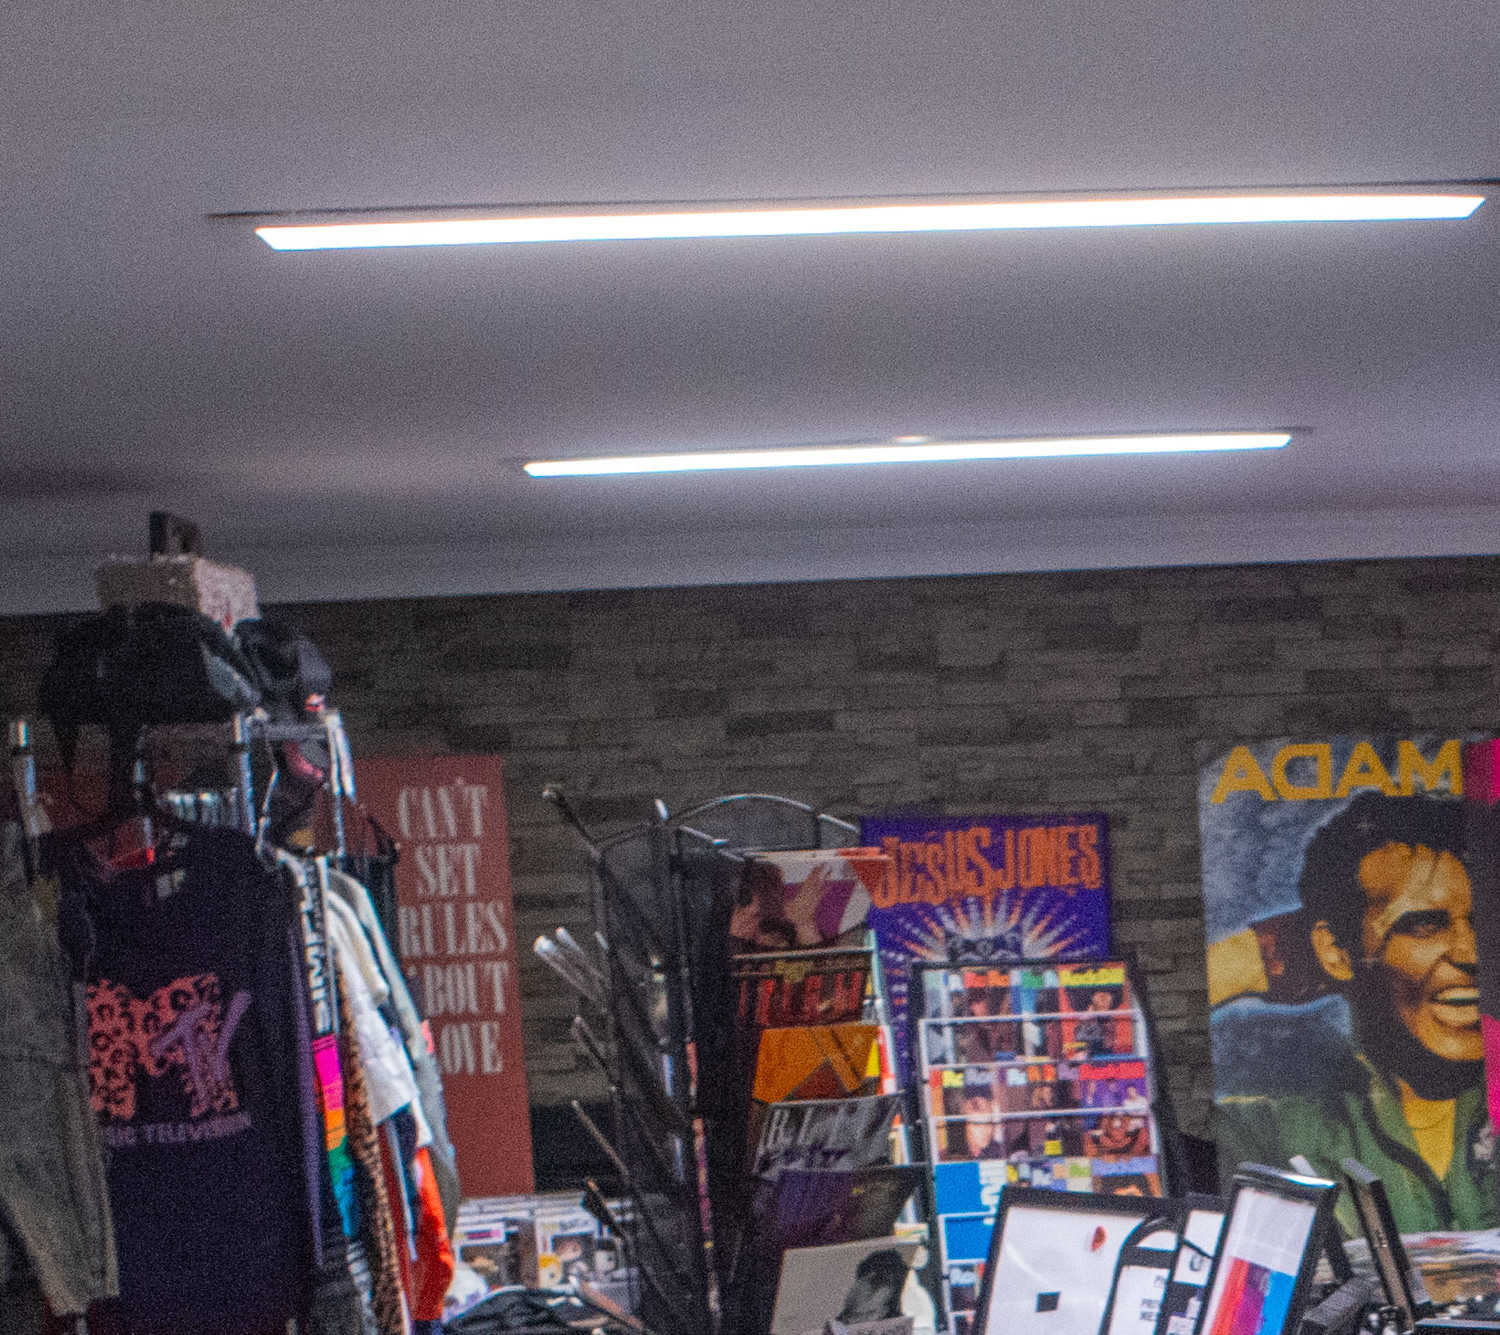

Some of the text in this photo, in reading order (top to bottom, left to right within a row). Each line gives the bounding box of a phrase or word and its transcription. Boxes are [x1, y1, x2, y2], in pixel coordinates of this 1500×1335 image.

[1210, 740, 1463, 803] ADAM
[401, 778, 488, 838] CAN'T
[416, 844, 480, 897] SET
[872, 825, 1100, 908] JESUS JONES
[401, 899, 509, 955] RULES
[440, 1020, 503, 1075] OVE
